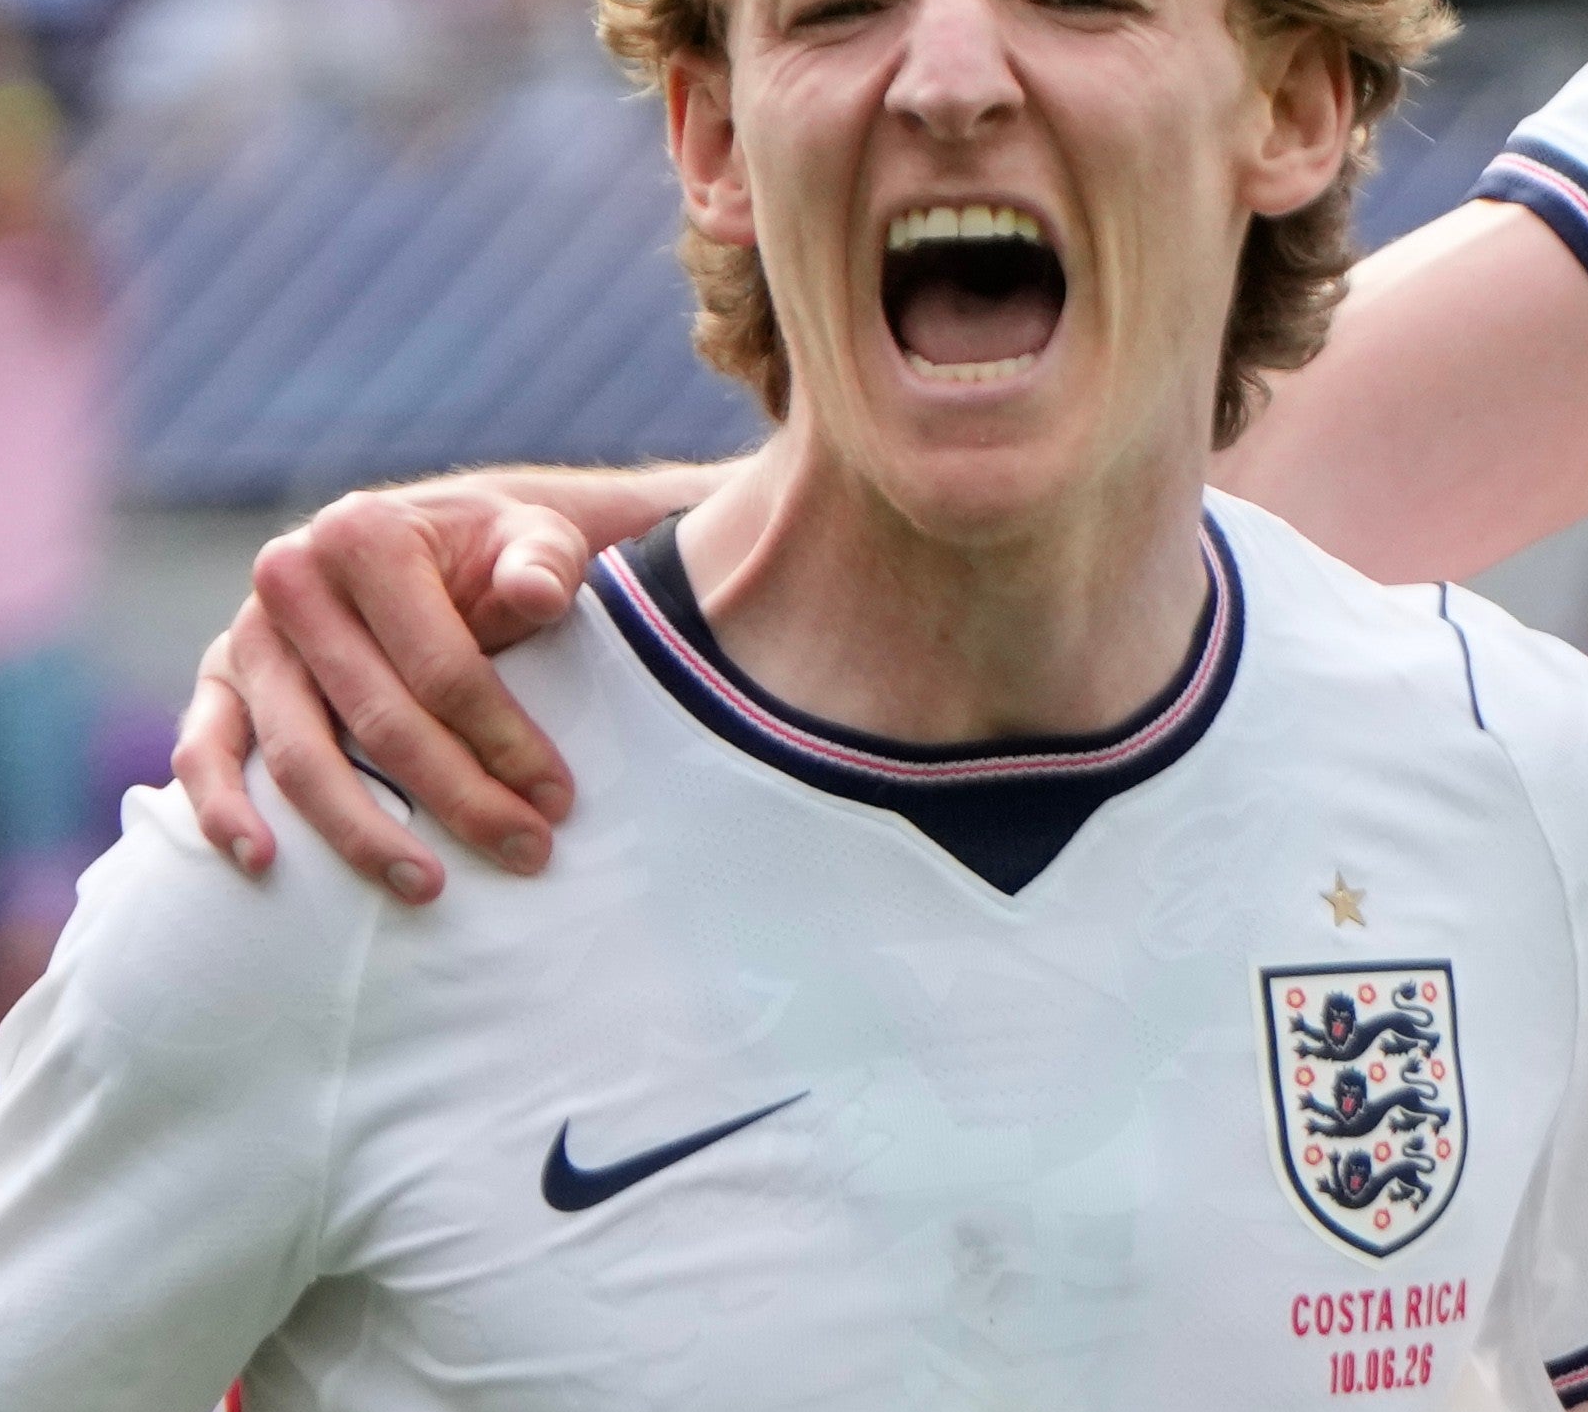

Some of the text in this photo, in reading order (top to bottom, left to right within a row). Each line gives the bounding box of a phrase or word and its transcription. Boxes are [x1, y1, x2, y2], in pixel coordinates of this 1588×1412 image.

[1291, 1278, 1467, 1337] COSTA RICA
[1329, 1342, 1433, 1394] 10.06.26
